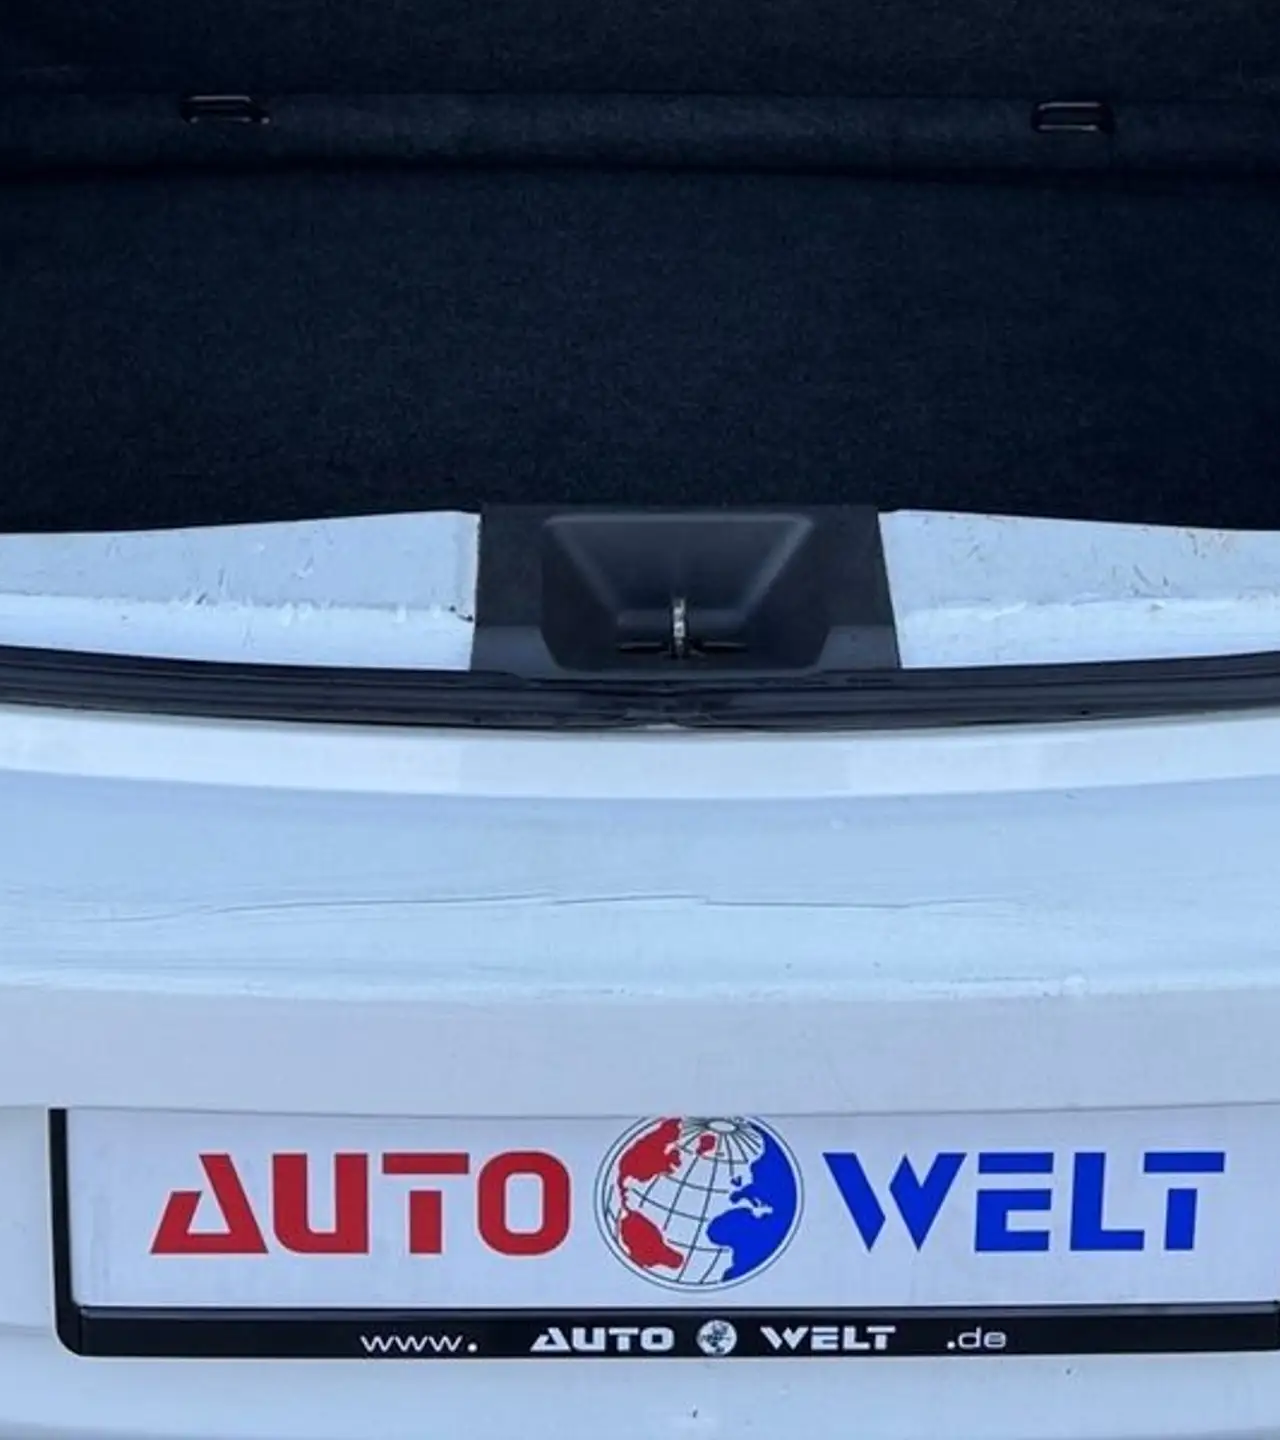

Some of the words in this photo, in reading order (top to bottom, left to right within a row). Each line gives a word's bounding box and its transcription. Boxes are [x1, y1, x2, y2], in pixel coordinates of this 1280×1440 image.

[150, 1151, 571, 1256] AUTO
[822, 1152, 1226, 1252] WELT
[360, 1334, 478, 1353] www.
[529, 1326, 675, 1352] AUTO
[760, 1325, 898, 1350] WELT
[946, 1327, 1008, 1350] .de
